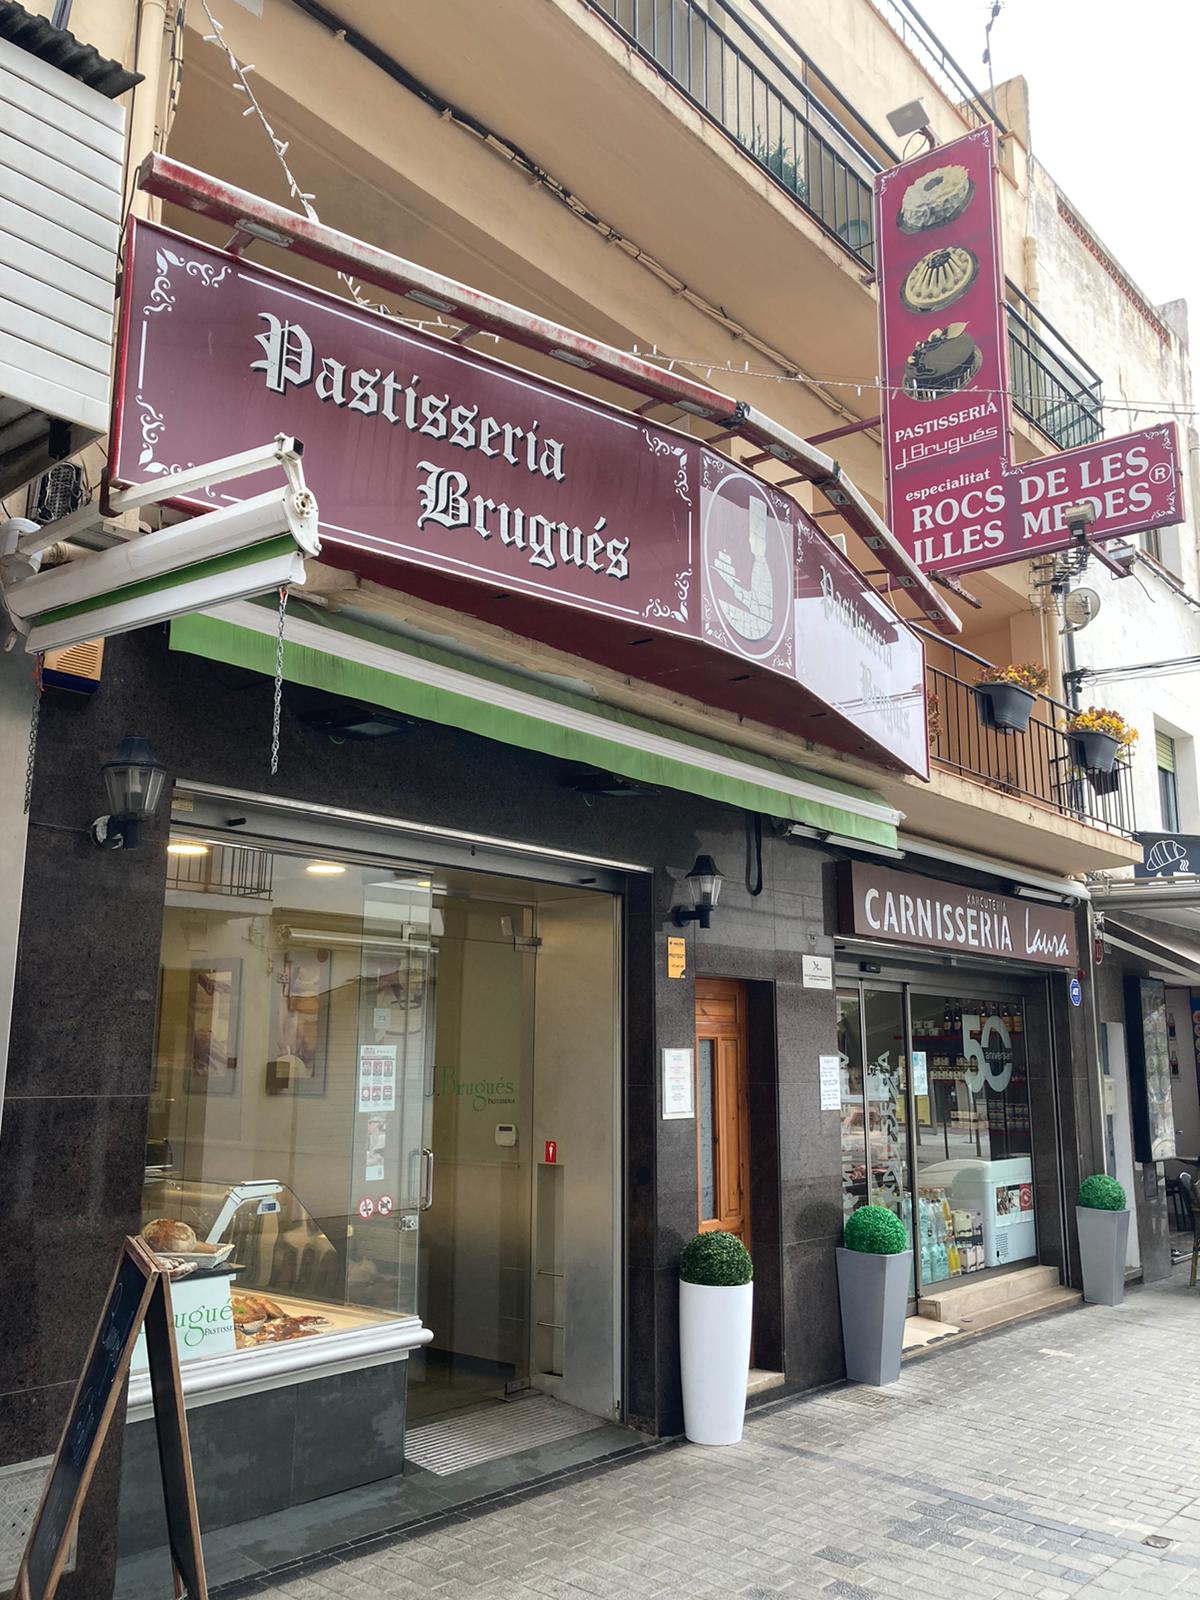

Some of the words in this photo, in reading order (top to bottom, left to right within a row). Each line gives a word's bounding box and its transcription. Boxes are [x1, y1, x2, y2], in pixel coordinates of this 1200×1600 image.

[250, 312, 566, 482] Pastisseria
[895, 401, 998, 443] PASTISSERIA
[416, 460, 630, 580] Brugués
[905, 469, 991, 502] especialitat
[912, 485, 1006, 534] ROCS
[1019, 467, 1069, 505] DE
[1080, 446, 1150, 497] LES
[913, 520, 1005, 566] ILLES
[863, 888, 1012, 952] CARNISSERIA
[1025, 907, 1069, 958] Laura
